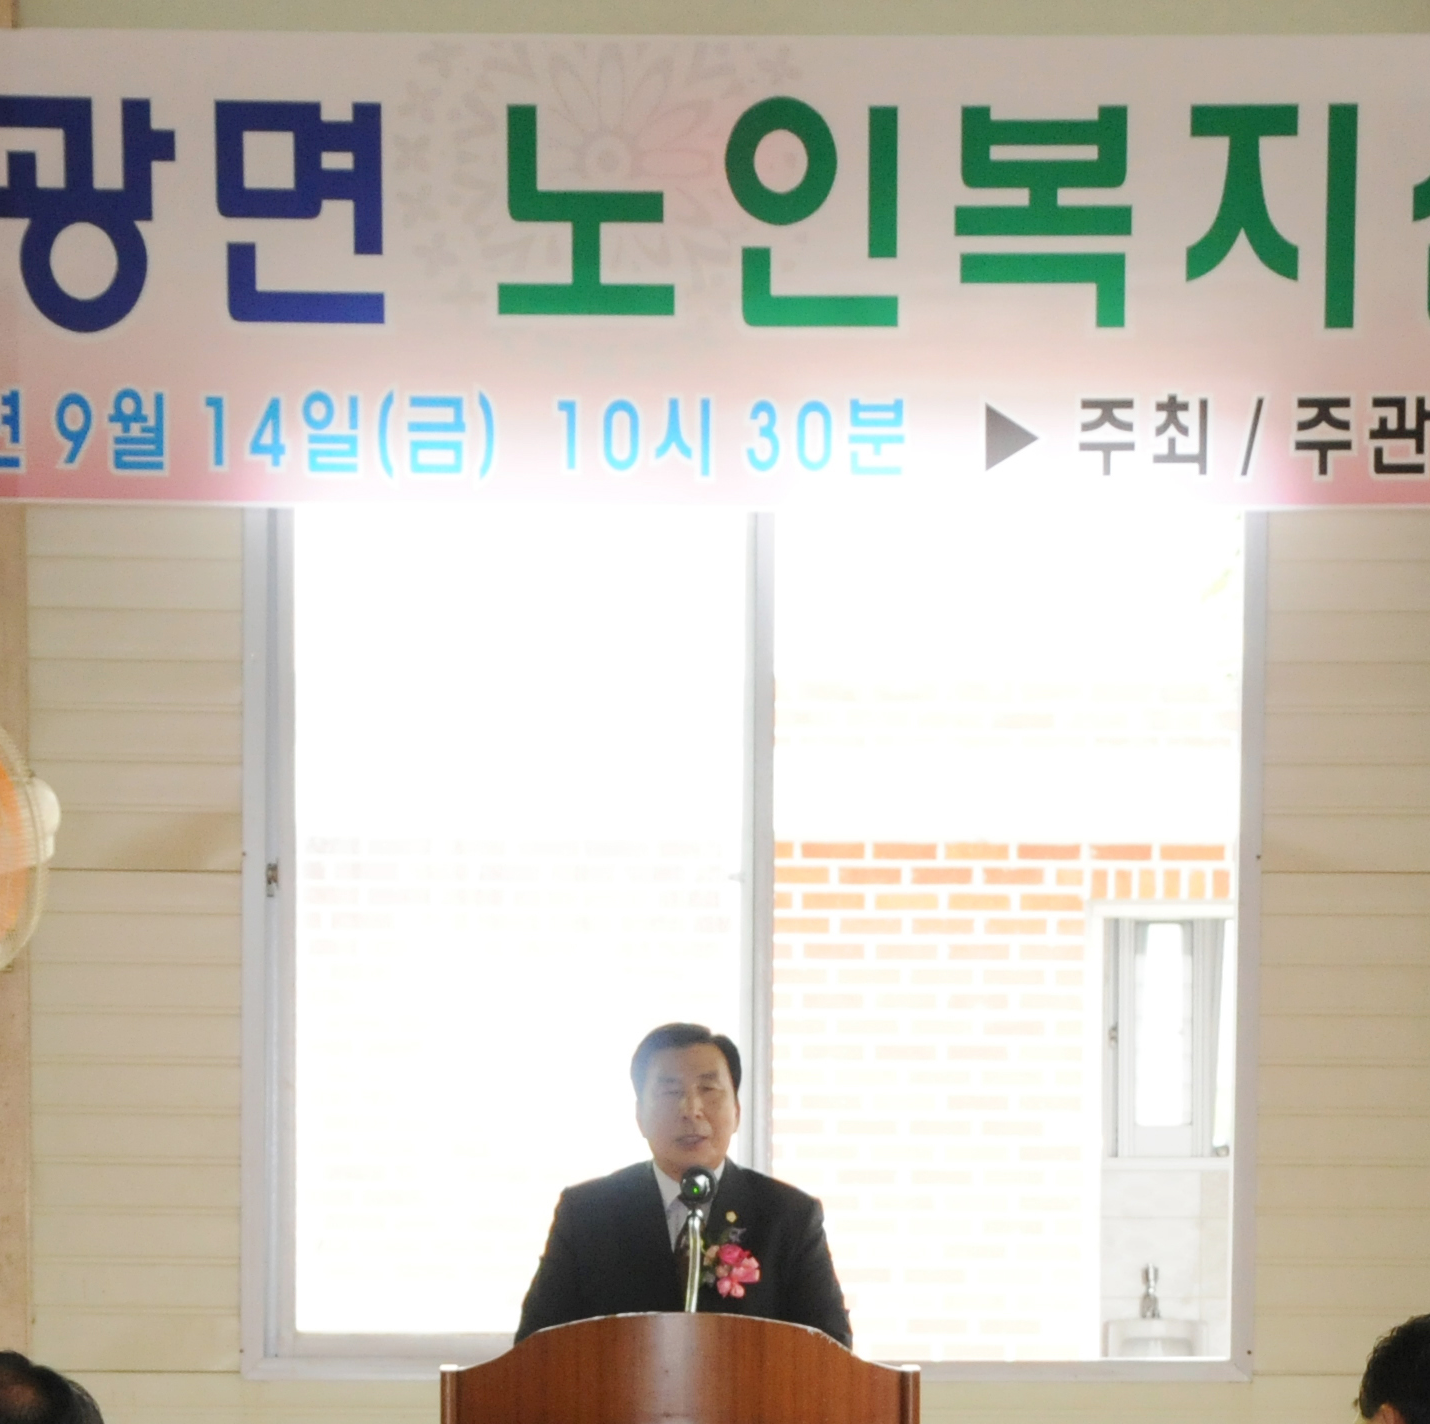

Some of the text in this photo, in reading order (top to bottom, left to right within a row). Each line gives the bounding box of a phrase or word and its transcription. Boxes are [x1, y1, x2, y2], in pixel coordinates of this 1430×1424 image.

[55, 388, 169, 471] 9월
[205, 390, 497, 479] 14일(금)
[557, 397, 714, 478] 10시
[746, 399, 908, 476] 30분
